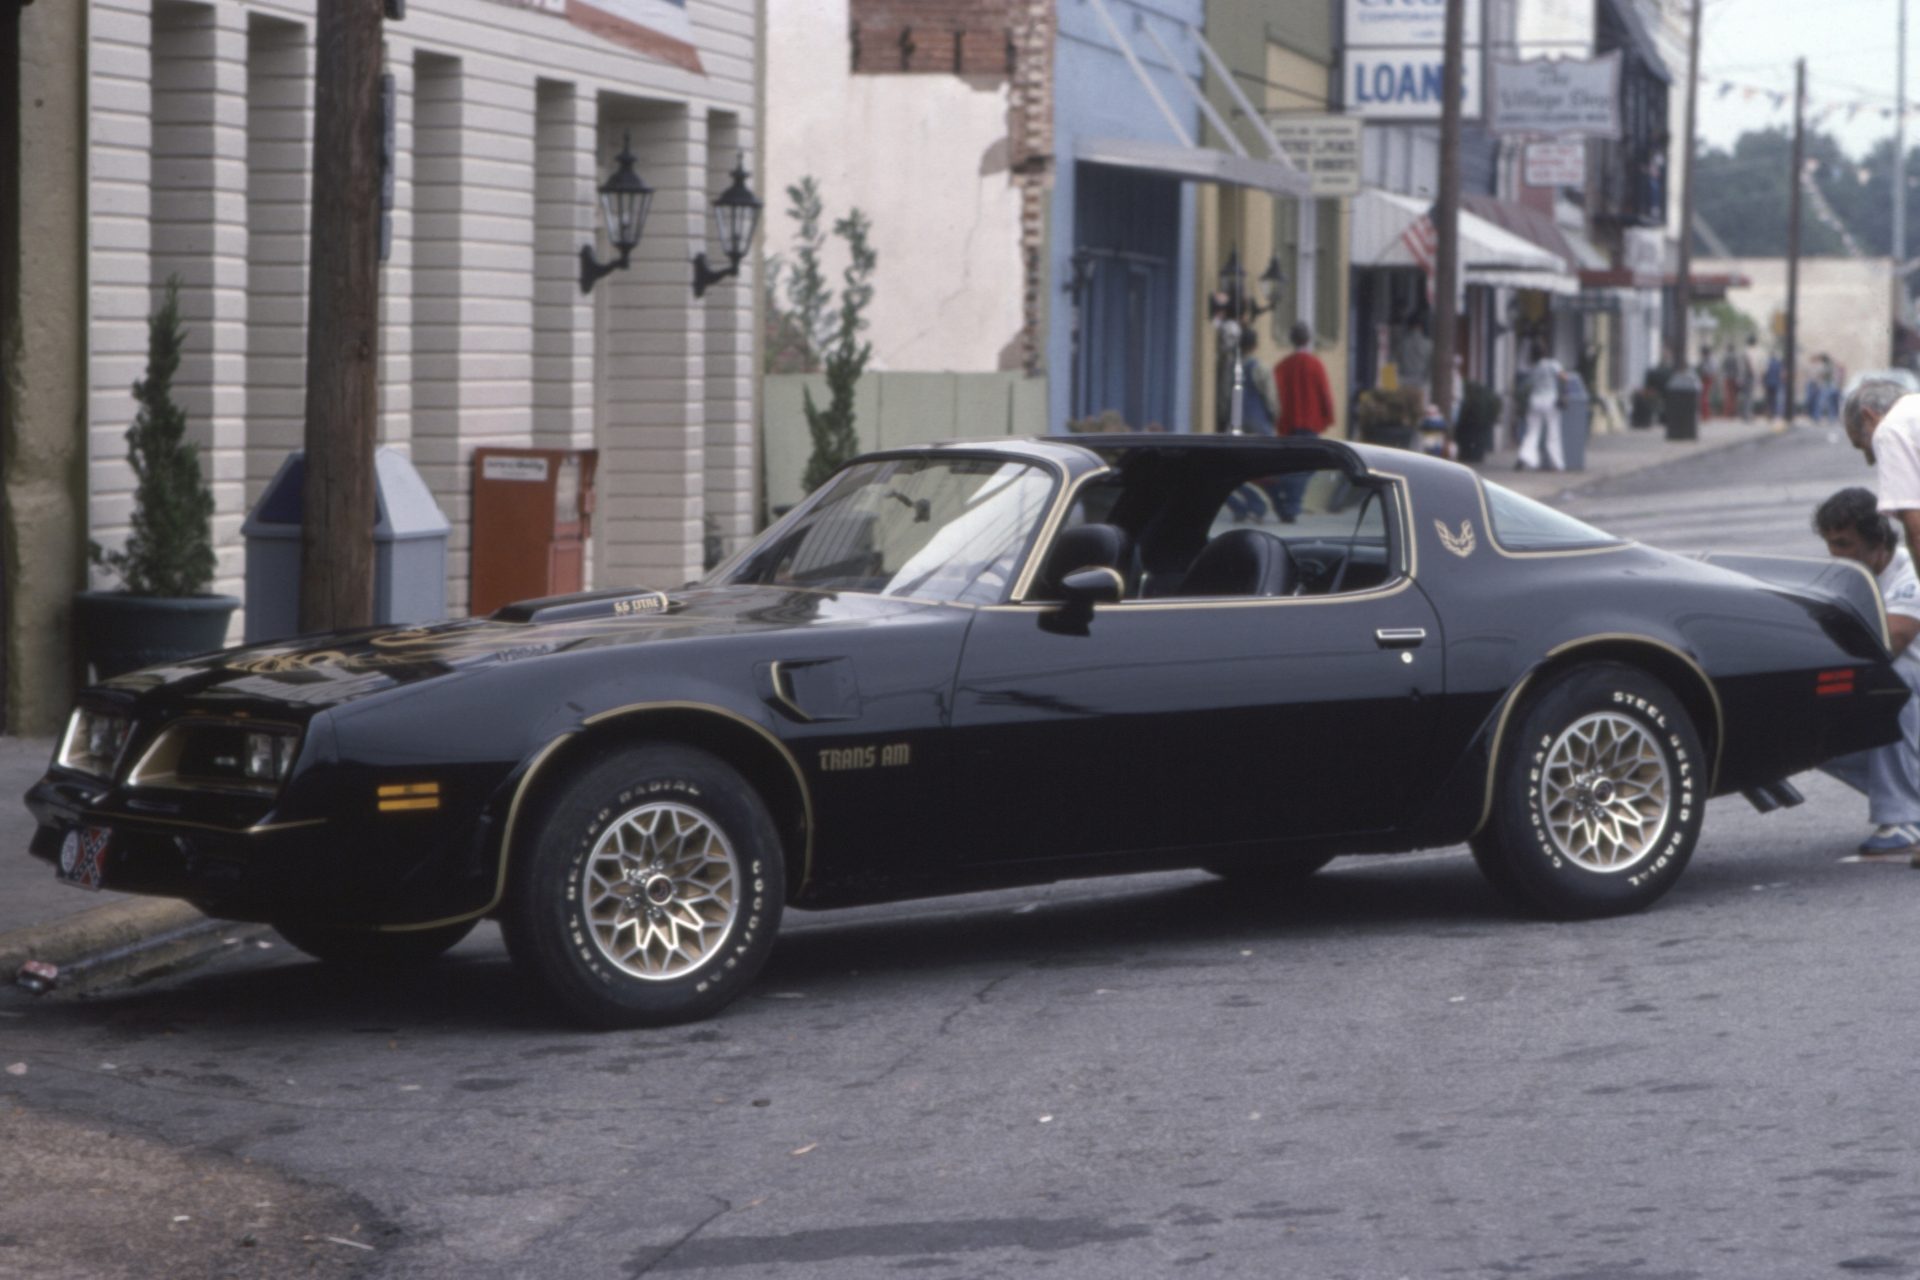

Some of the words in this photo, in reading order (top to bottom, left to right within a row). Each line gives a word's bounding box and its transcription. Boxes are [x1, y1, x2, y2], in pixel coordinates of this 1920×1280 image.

[1356, 64, 1467, 103] LOAN
[632, 597, 659, 610] LITRE
[1613, 691, 1667, 728] STEEL
[818, 746, 877, 772] TRANS
[881, 743, 910, 768] AM
[619, 780, 701, 803] RADIAL
[1669, 733, 1693, 823] BELTED
[1528, 734, 1563, 870] GOODYEAR
[1627, 831, 1683, 887] RADIAL
[696, 859, 765, 993] GOODYEAR
